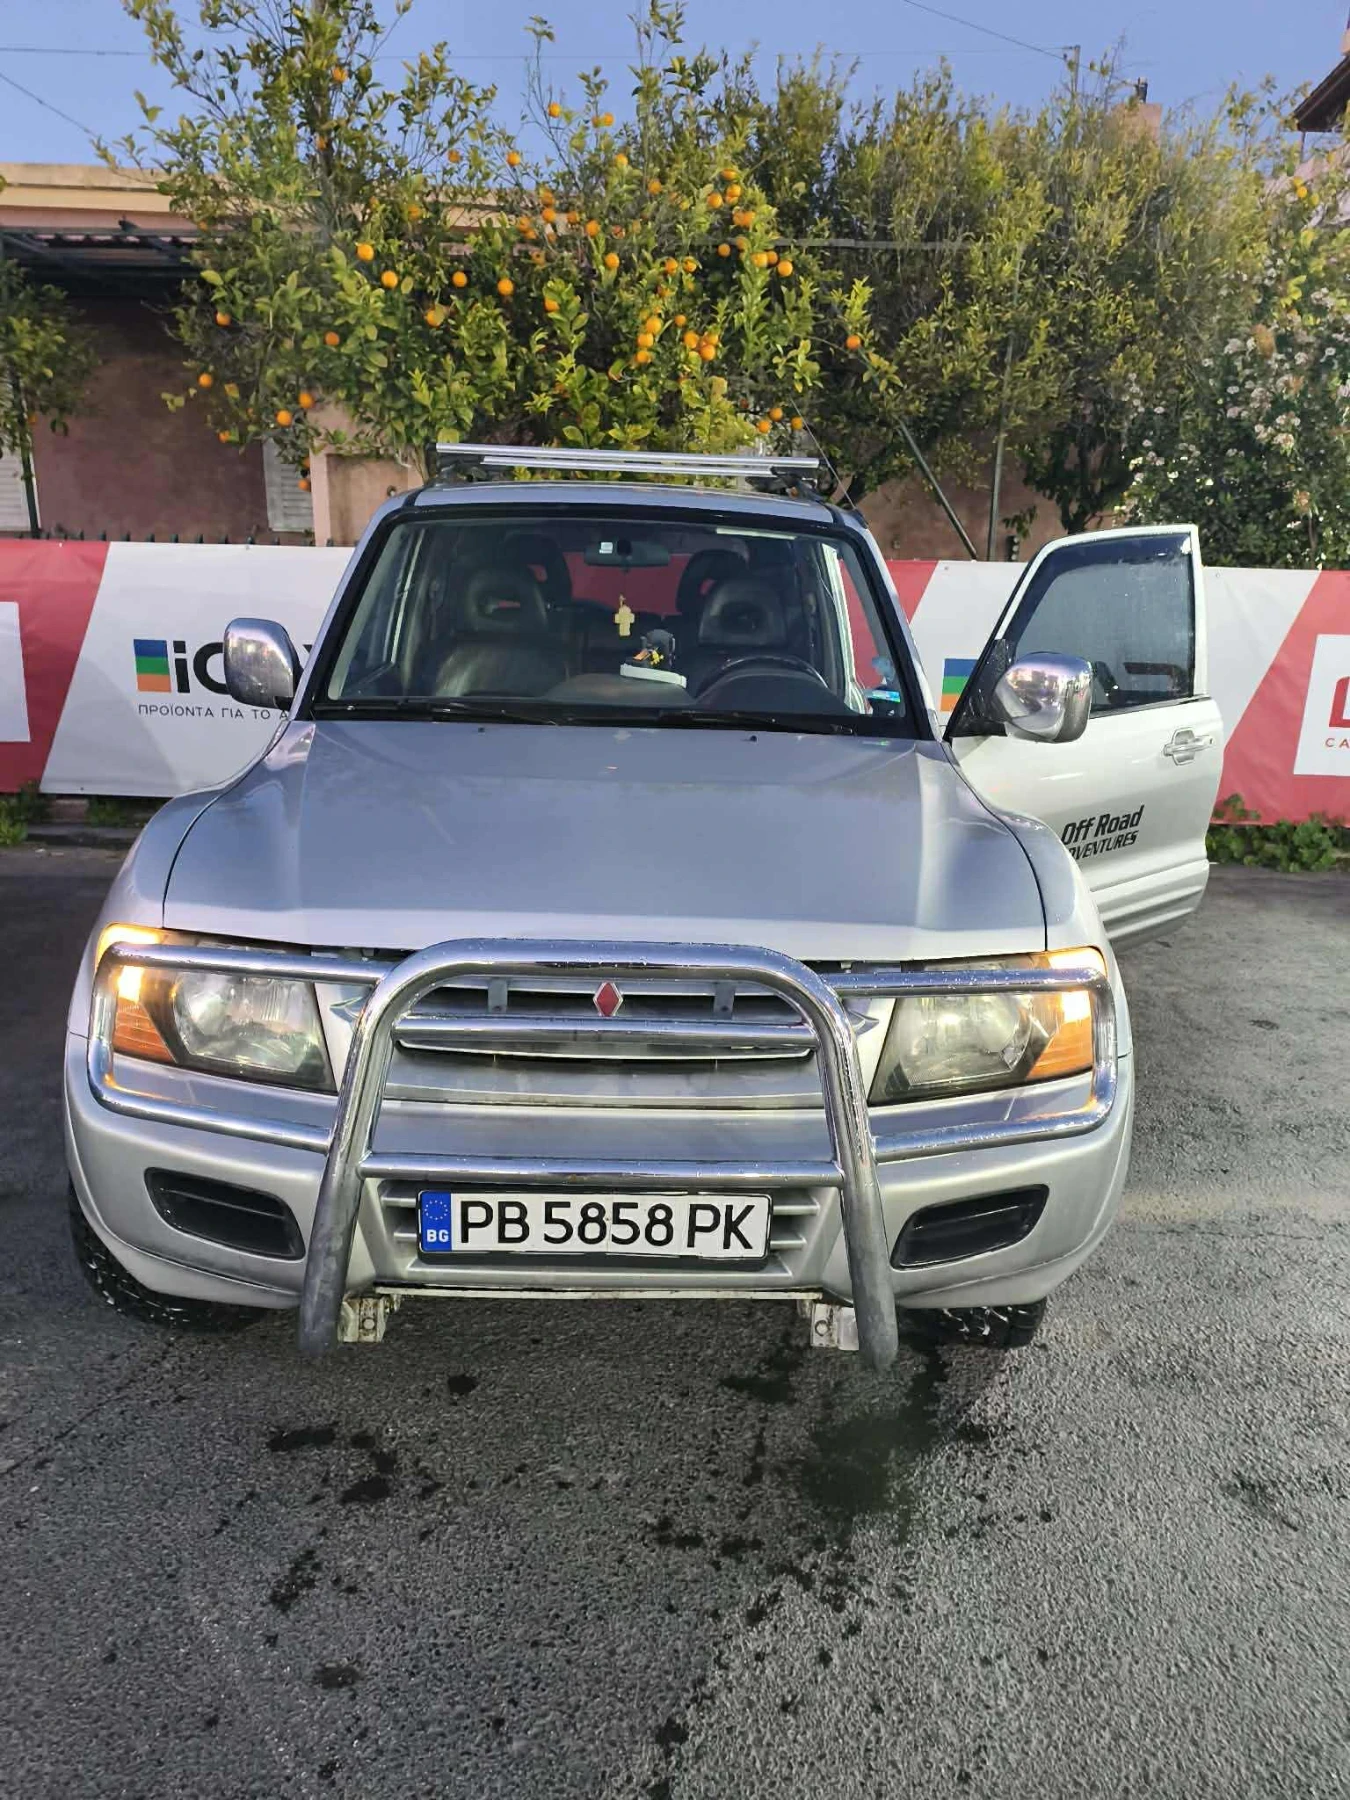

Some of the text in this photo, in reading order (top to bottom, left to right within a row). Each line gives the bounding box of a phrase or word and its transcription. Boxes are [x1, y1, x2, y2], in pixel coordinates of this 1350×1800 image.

[138, 704, 214, 718] ΠΡΟΪΟΝΤΑ
[221, 707, 244, 719] ΓΙΑ
[253, 709, 271, 720] ΤΟ
[1061, 804, 1145, 846] Off Road
[1069, 829, 1140, 861] DVENTURES
[426, 1229, 449, 1243] BG
[460, 1200, 755, 1250] PB 5858 PK
